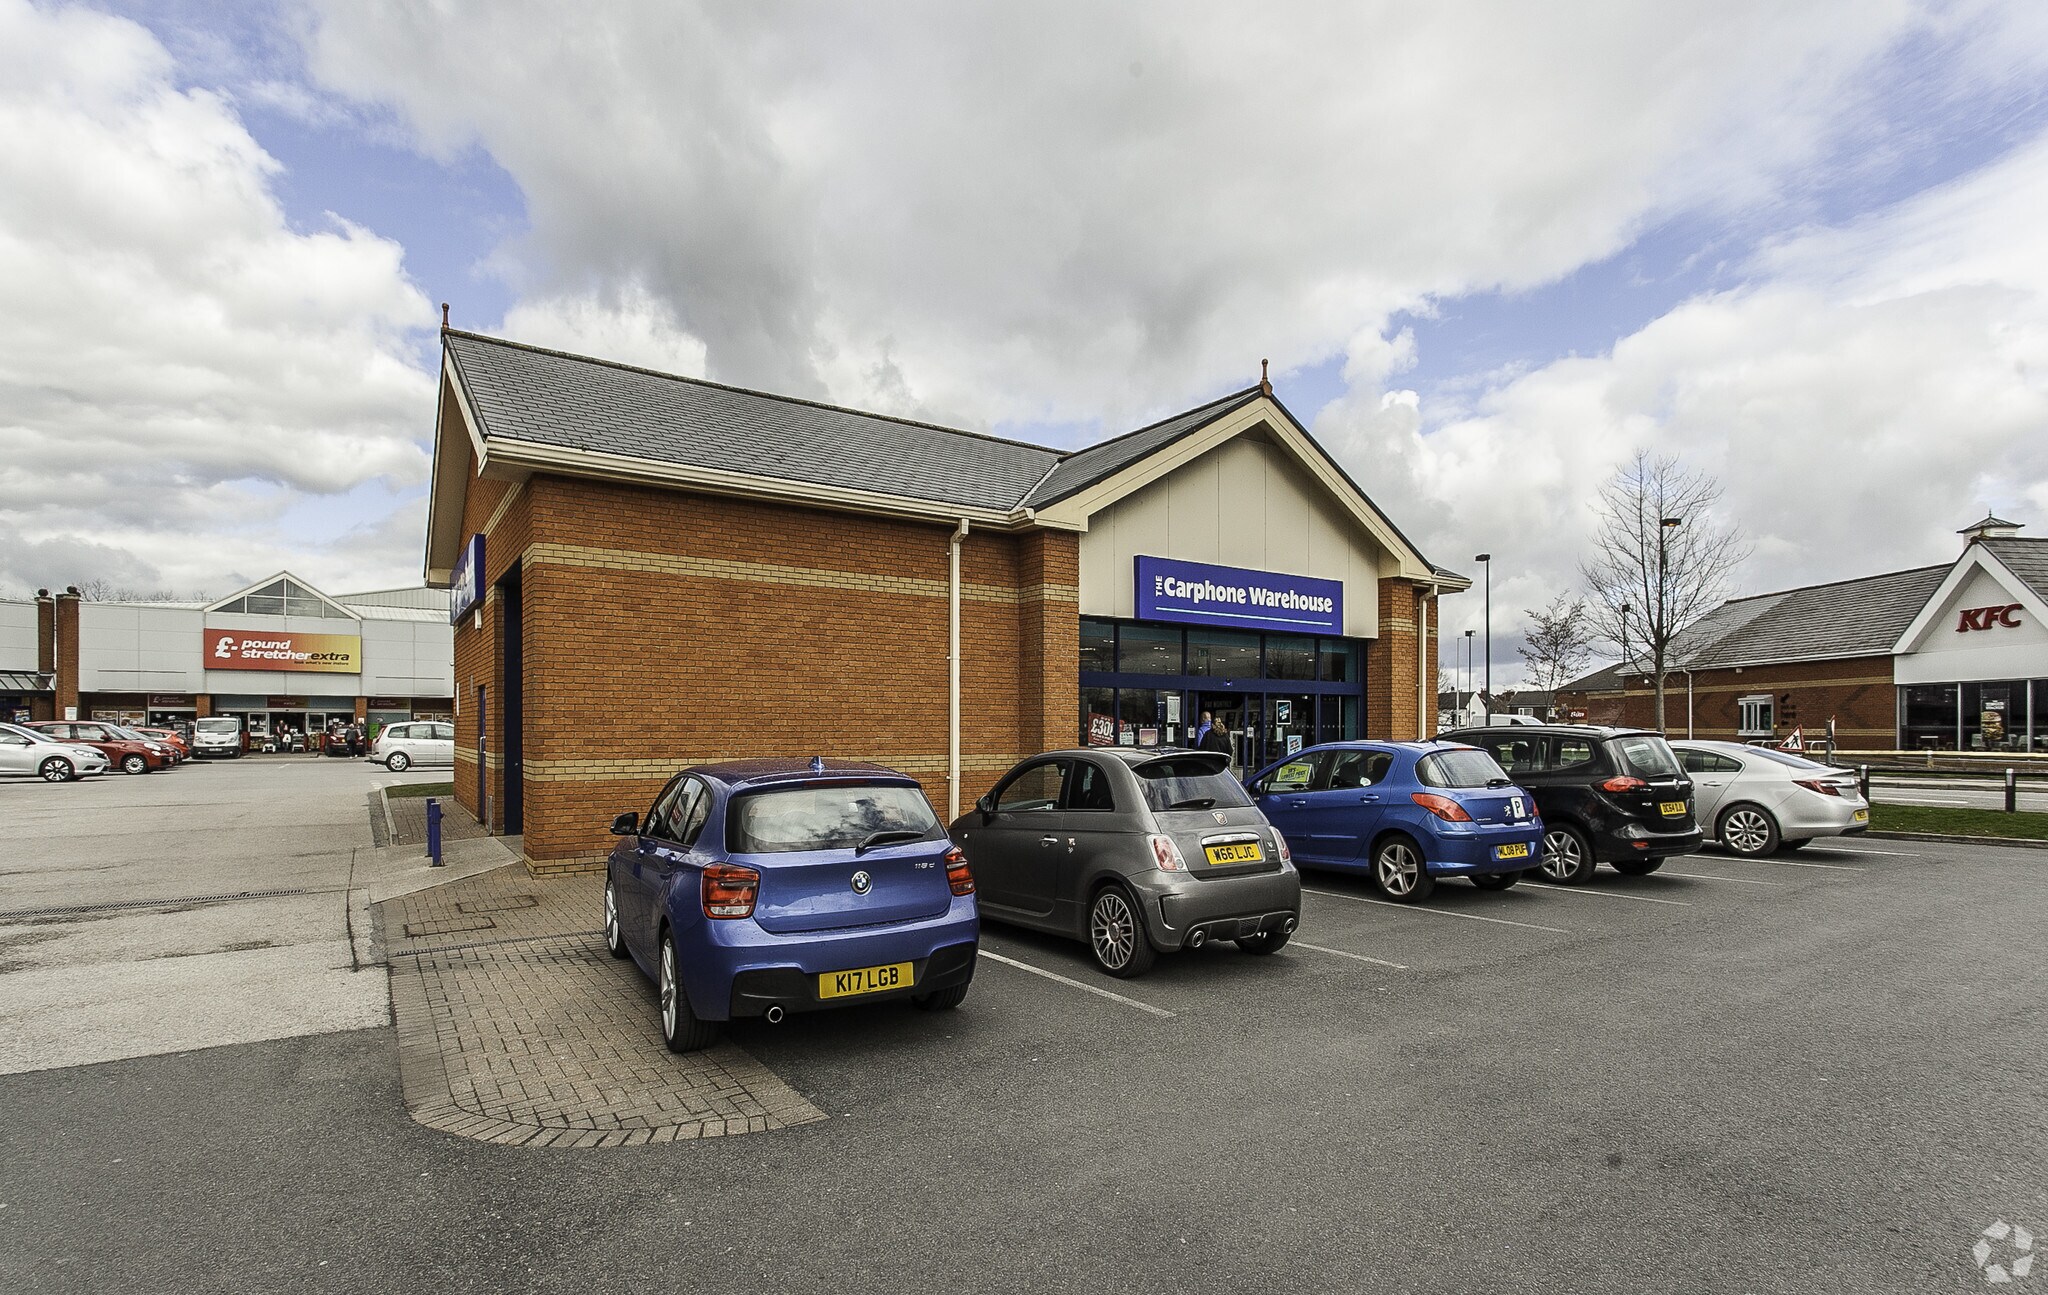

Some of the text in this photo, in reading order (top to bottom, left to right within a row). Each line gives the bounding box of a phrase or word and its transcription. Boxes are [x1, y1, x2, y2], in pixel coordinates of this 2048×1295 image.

[1155, 575, 1333, 613] THE Carphone Warehouse
[1955, 603, 2024, 633] KFC
[241, 639, 292, 650] pound
[1514, 801, 1521, 814] P
[1234, 846, 1254, 859] LJC
[836, 966, 899, 993] K17 LGB
